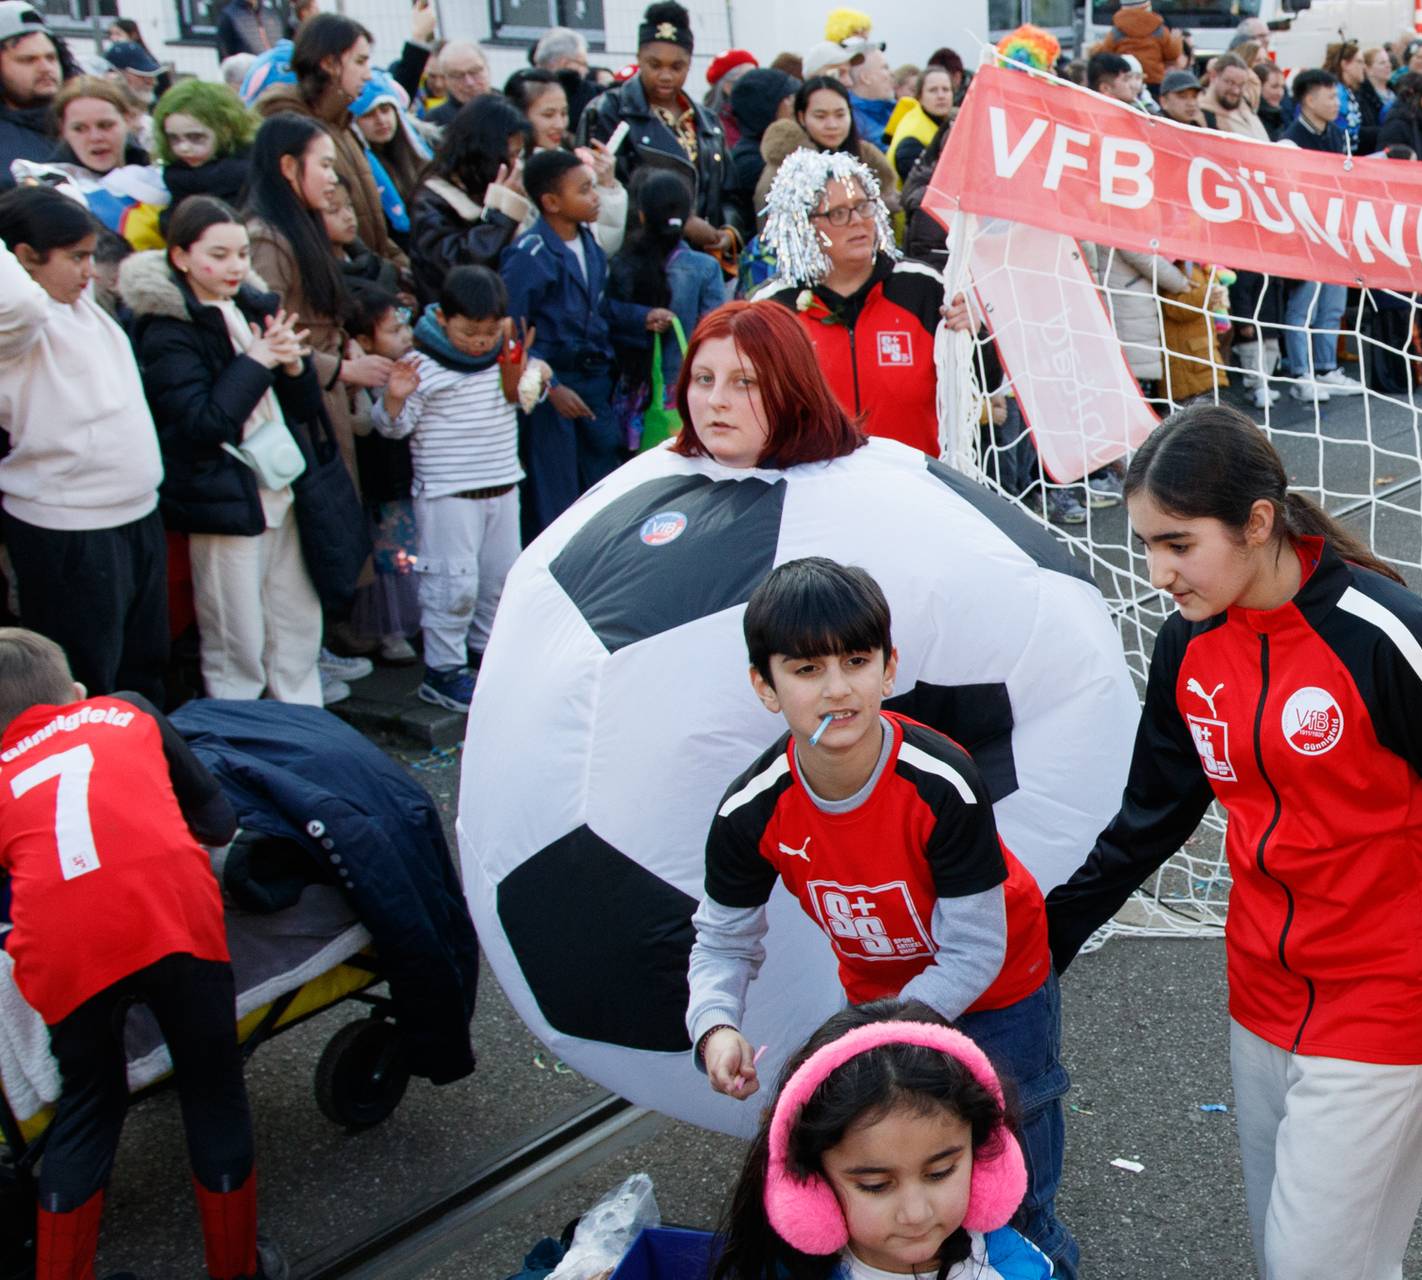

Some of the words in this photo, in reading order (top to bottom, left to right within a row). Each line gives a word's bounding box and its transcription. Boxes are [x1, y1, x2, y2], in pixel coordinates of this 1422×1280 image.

[990, 107, 1154, 209] VFB
[1296, 708, 1329, 732] VfB
[1303, 718, 1339, 750] Günnigfeld
[10, 743, 101, 881] 7
